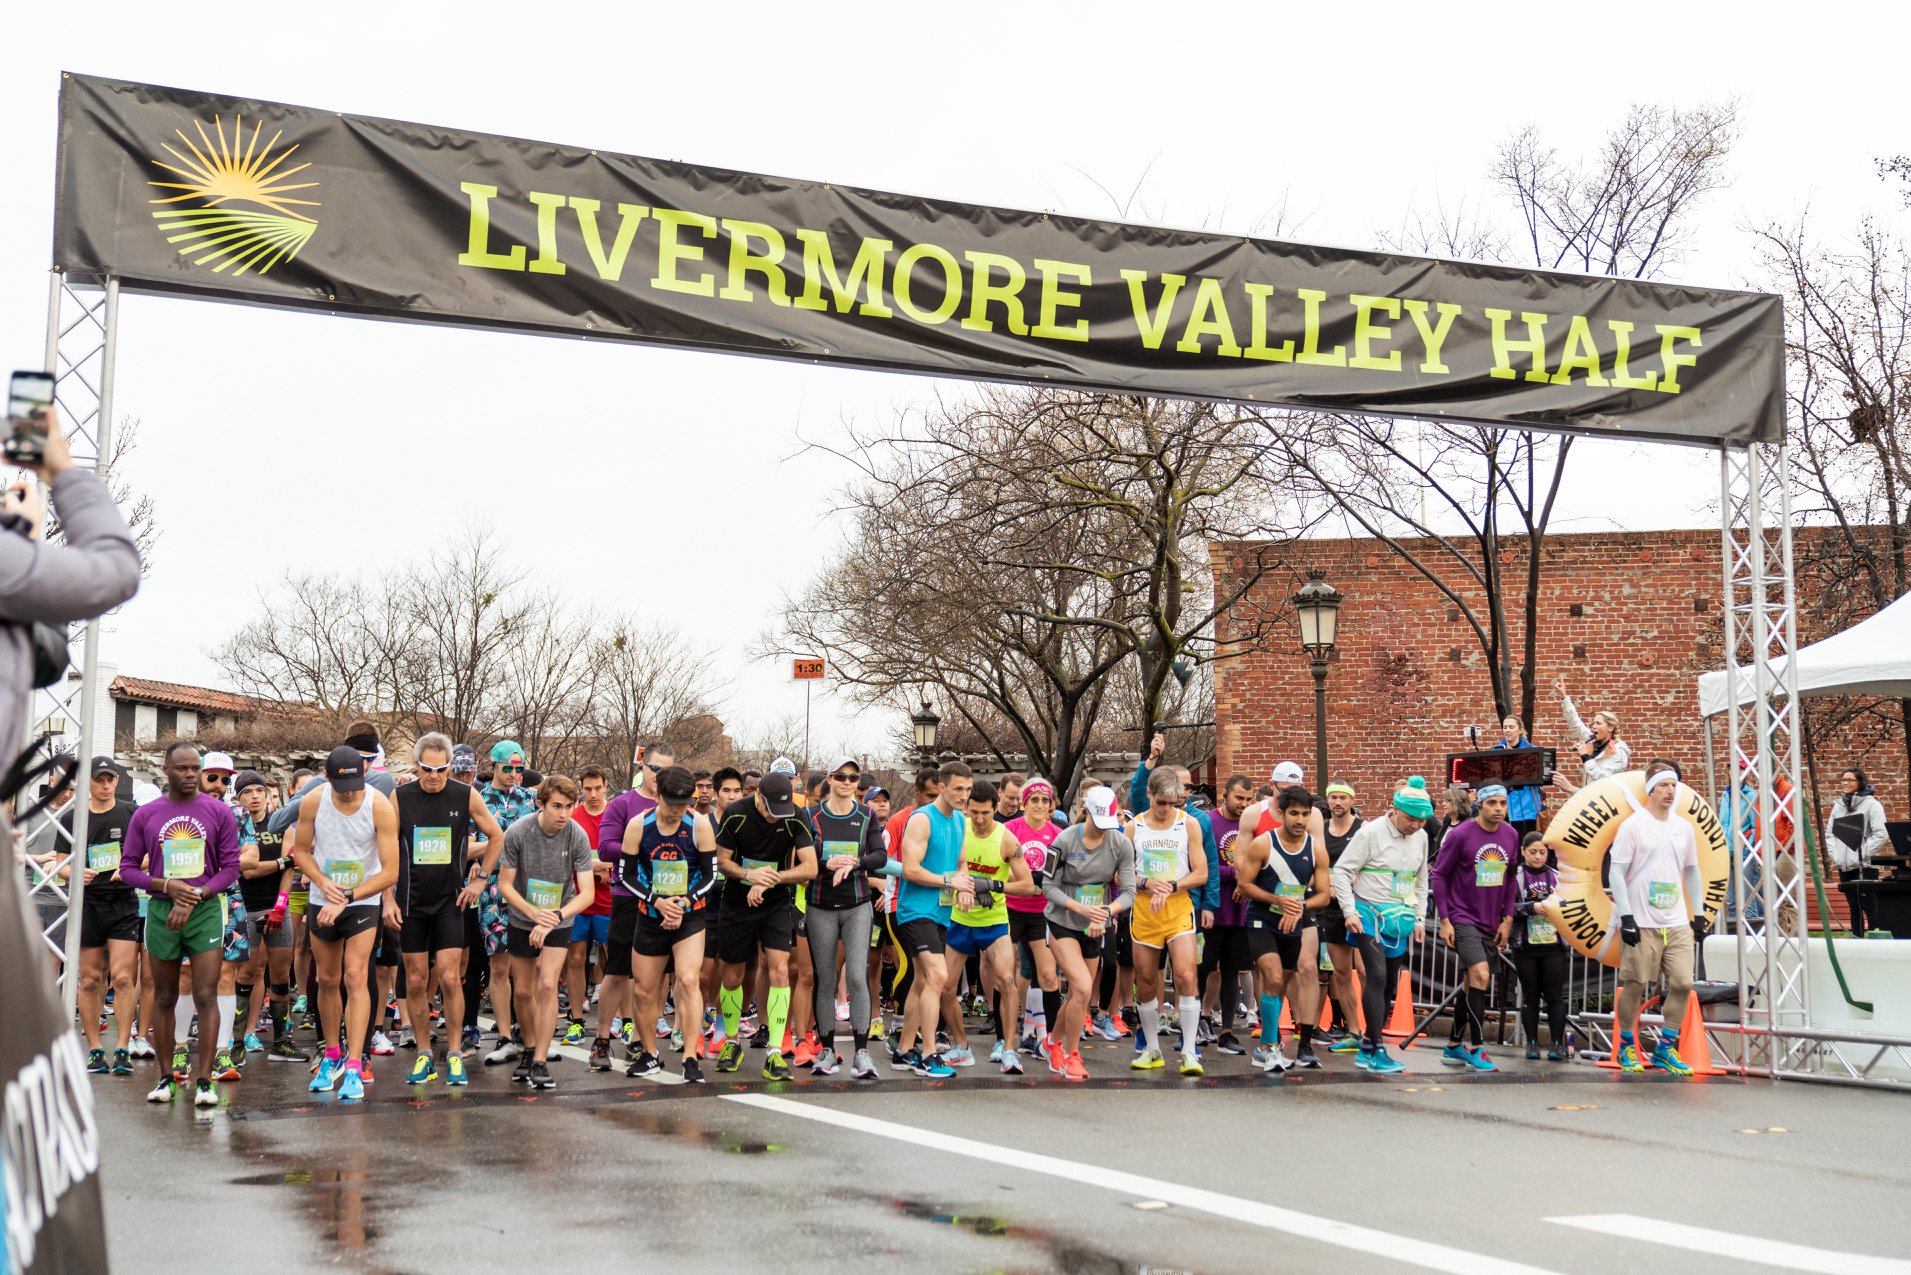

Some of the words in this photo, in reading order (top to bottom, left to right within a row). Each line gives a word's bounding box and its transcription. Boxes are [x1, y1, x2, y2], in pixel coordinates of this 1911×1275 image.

[458, 182, 1093, 342] LIVERMORE
[1120, 269, 1462, 374] VALLEY
[1485, 308, 1702, 394] HALF
[797, 664, 822, 673] 1:30
[159, 816, 190, 841] LIVERMORE
[1563, 795, 1619, 849] WHEEL
[1688, 795, 1727, 851] DONUT
[418, 840, 447, 852] 1928
[1142, 839, 1179, 850] GRANADA
[169, 852, 199, 866] 1951
[660, 851, 677, 860] GG
[1475, 843, 1497, 862] LIVERMORE
[92, 854, 119, 869] 2024
[1150, 861, 1170, 872] 589
[330, 873, 358, 884] 1749
[657, 873, 684, 885] 1224
[532, 892, 557, 904] 1164
[1559, 898, 1606, 949] DONUT
